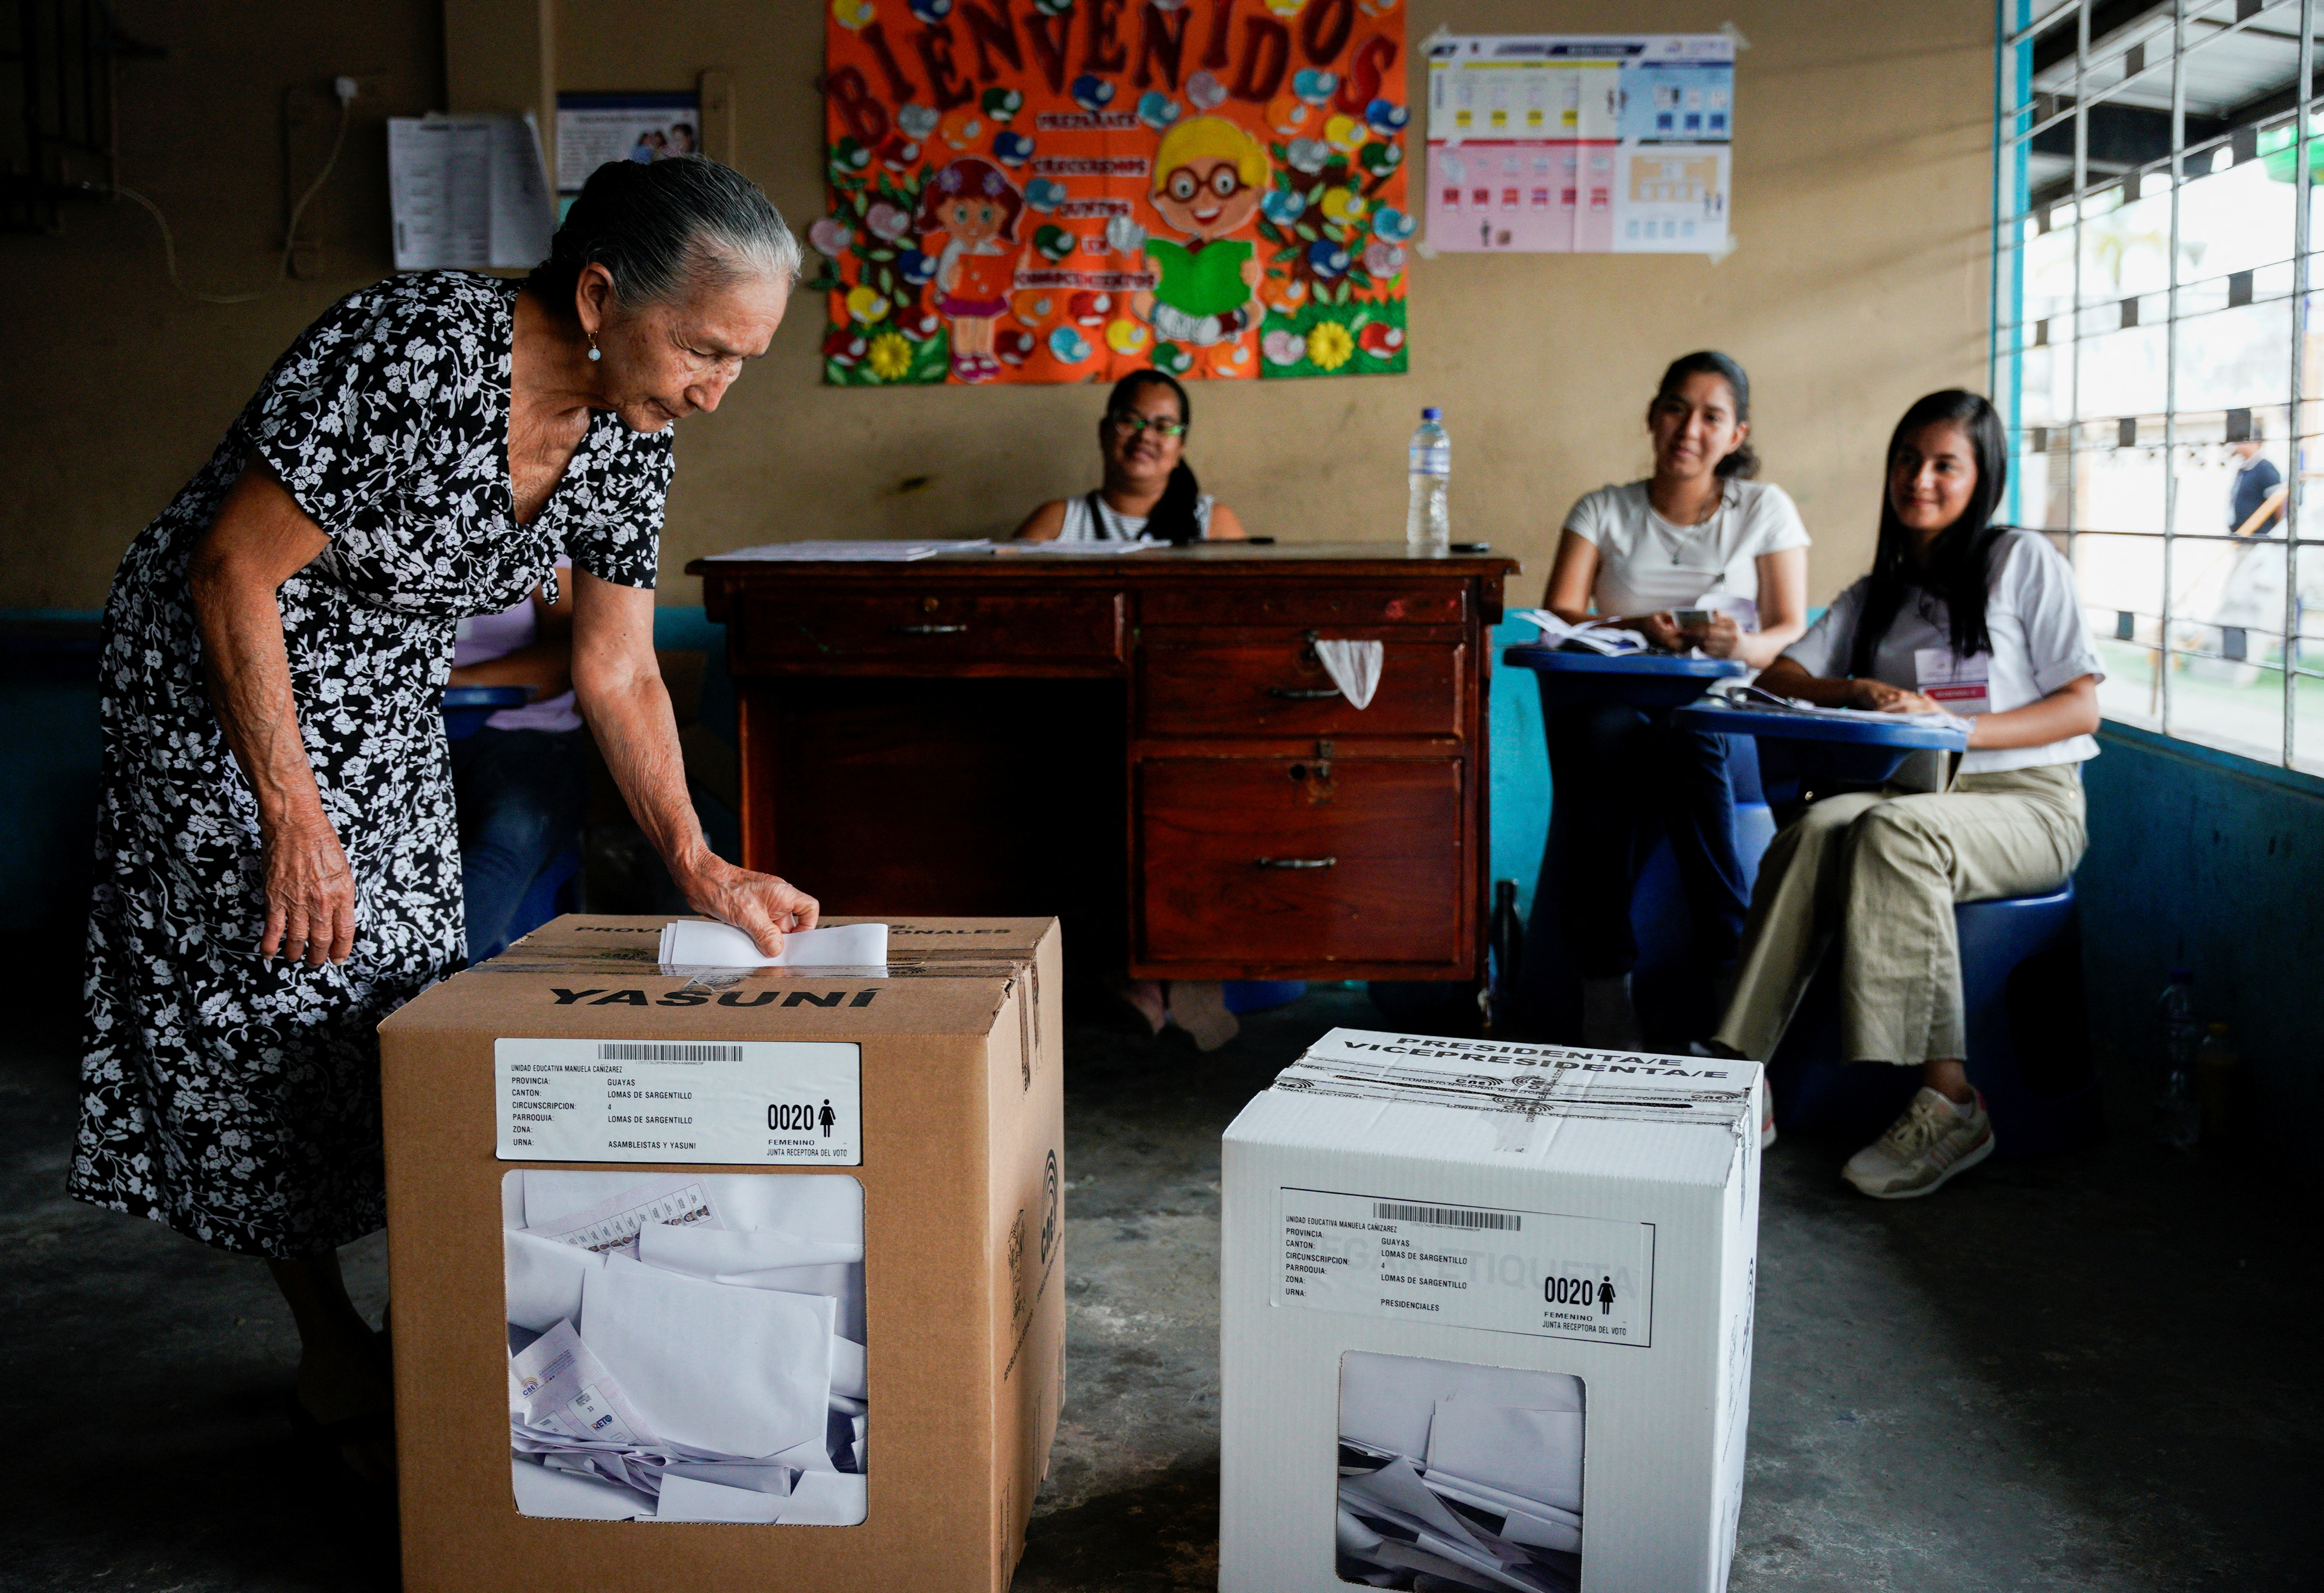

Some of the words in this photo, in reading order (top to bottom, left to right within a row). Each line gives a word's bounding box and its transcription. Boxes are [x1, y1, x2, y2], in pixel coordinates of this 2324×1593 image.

[822, 0, 1397, 150] BIENVENIDOS
[549, 988, 884, 1008] YASUNÍ
[1344, 1041, 1729, 1078] VICEPRESIDENTA/E
[1396, 1037, 1683, 1066] PRESIDENTA/E
[607, 1078, 636, 1086] GUAYAS
[608, 1090, 631, 1098] LOMAS
[645, 1091, 692, 1100] SARGENTILLO
[512, 1101, 577, 1110] CIRCUNSCRIPCION:
[513, 1113, 554, 1121] PARROQUIA:
[645, 1116, 693, 1124] SARGENTILLO
[767, 1104, 814, 1131] 0020
[608, 1141, 661, 1149] ASAMBLEISTAS
[670, 1142, 696, 1150] YASUNI
[786, 1148, 819, 1156] RECEPTORA
[821, 1149, 831, 1157] DEL
[832, 1149, 847, 1157] VOTO
[1286, 1215, 1306, 1224] UNIDAD
[1307, 1217, 1337, 1227] EDUCATIVA
[1339, 1221, 1366, 1230] MANUELA
[1286, 1227, 1324, 1238] PROVINCIA:
[1381, 1237, 1410, 1247] GUAYAS
[1286, 1239, 1315, 1249] CANTON:
[1381, 1249, 1405, 1259] LOMAS
[1407, 1252, 1417, 1260] DE
[1419, 1253, 1468, 1265] SARGENTILLO
[1286, 1251, 1350, 1267] CIRCUNSCRIPCION:
[1285, 1275, 1305, 1284] ZONA:
[1286, 1263, 1327, 1274] PARROQUIA:
[1381, 1274, 1405, 1283] LOMAS
[1419, 1277, 1467, 1289] SARGENTILLO
[1544, 1276, 1593, 1306] 0020
[1285, 1288, 1307, 1297] URNA:
[1380, 1298, 1440, 1312] PRESIDENCIALES
[1544, 1311, 1593, 1322] FEMENINO
[1542, 1320, 1561, 1329] JUNTA
[1563, 1322, 1596, 1333] RECEPTORA
[1598, 1325, 1609, 1334] DEL
[1611, 1327, 1626, 1336] VOTO
